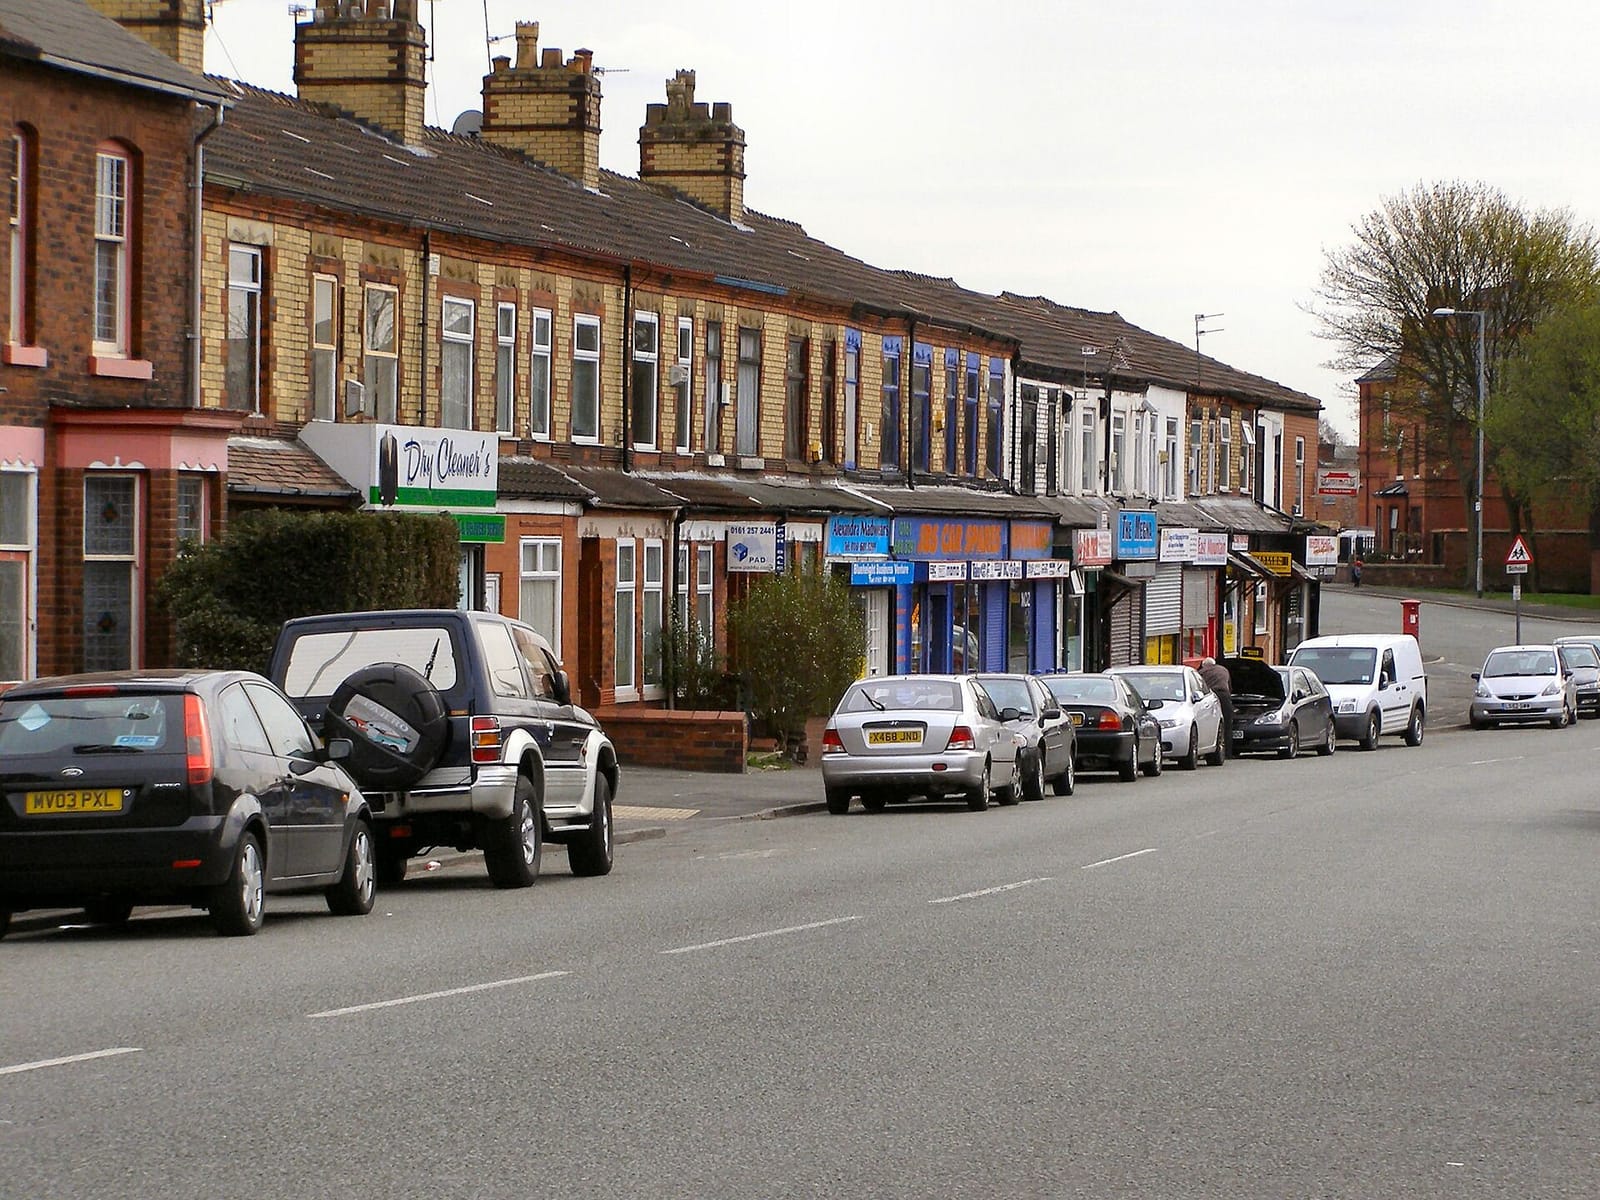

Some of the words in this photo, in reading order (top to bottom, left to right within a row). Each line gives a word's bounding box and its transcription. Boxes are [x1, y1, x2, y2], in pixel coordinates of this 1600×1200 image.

[403, 437, 434, 490] Dry
[437, 437, 491, 483] Cleaner's
[730, 526, 746, 534] 0161
[747, 527, 759, 535] 257
[941, 523, 963, 554] CAR
[873, 731, 898, 742] X468
[34, 792, 78, 809] MV03
[81, 791, 114, 808] PXL
